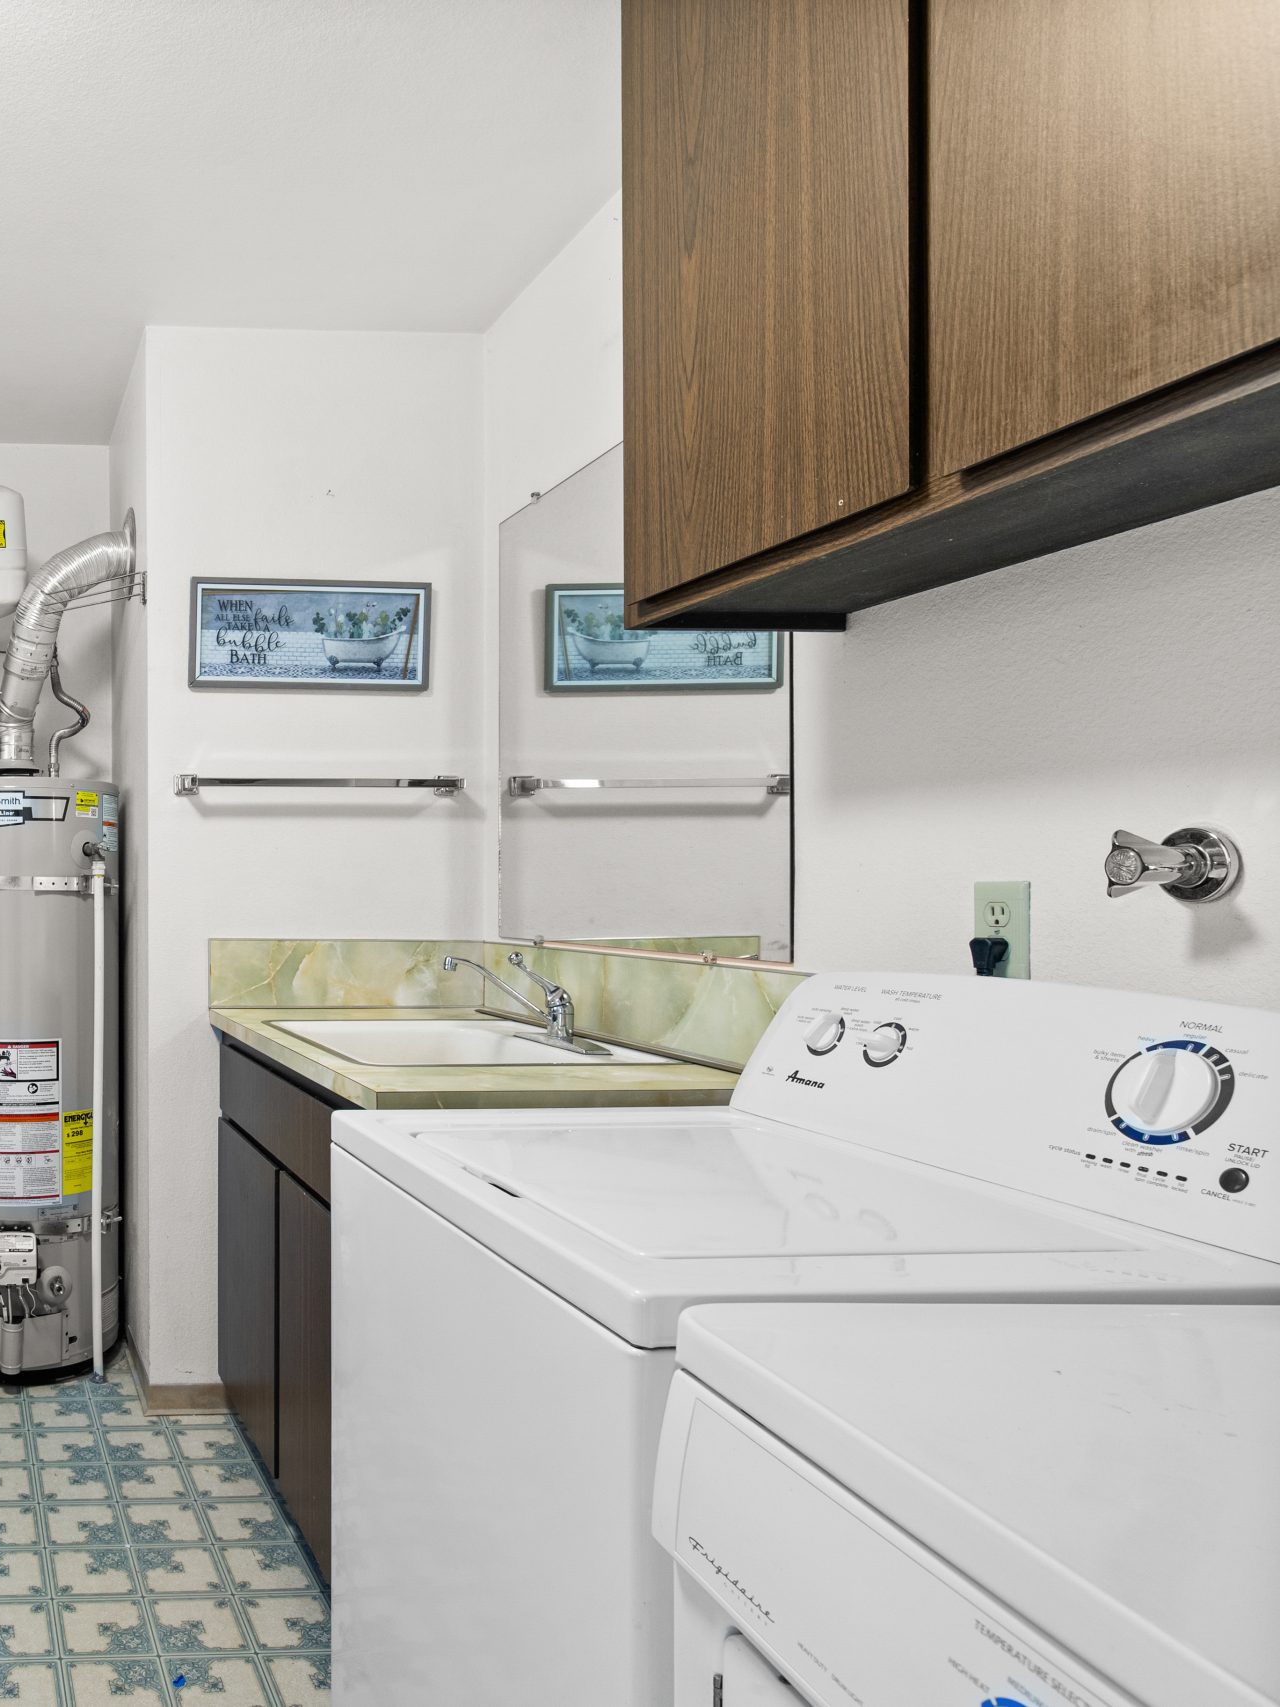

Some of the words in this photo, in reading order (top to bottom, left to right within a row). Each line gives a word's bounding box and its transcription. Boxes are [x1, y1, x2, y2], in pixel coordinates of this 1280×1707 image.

[217, 599, 253, 612] WHEN
[232, 614, 250, 622] ELSE
[253, 604, 294, 631] fails
[226, 622, 254, 631] TAKE
[263, 624, 270, 632] A
[216, 626, 286, 653] bubble
[900, 990, 942, 1000] TEMPERATURE
[1179, 1020, 1224, 1034] NORMAL
[786, 1070, 825, 1088] Amana
[1238, 1072, 1269, 1080] delicate
[1086, 1126, 1117, 1136] drain/spin
[1048, 1144, 1063, 1152] cycle
[1064, 1147, 1081, 1156] status
[1122, 1140, 1139, 1148] clean
[1140, 1144, 1164, 1152] washer
[1176, 1145, 1210, 1157] rinse/spin
[1227, 1143, 1270, 1158] START
[1224, 1157, 1249, 1166] UNLOCK
[1200, 1189, 1231, 1201] CANCEL
[688, 1536, 775, 1623] Frigidaire
[974, 1618, 1050, 1683] TEMPERATURE
[948, 1657, 968, 1678] HIGH
[969, 1676, 990, 1694] HEAT
